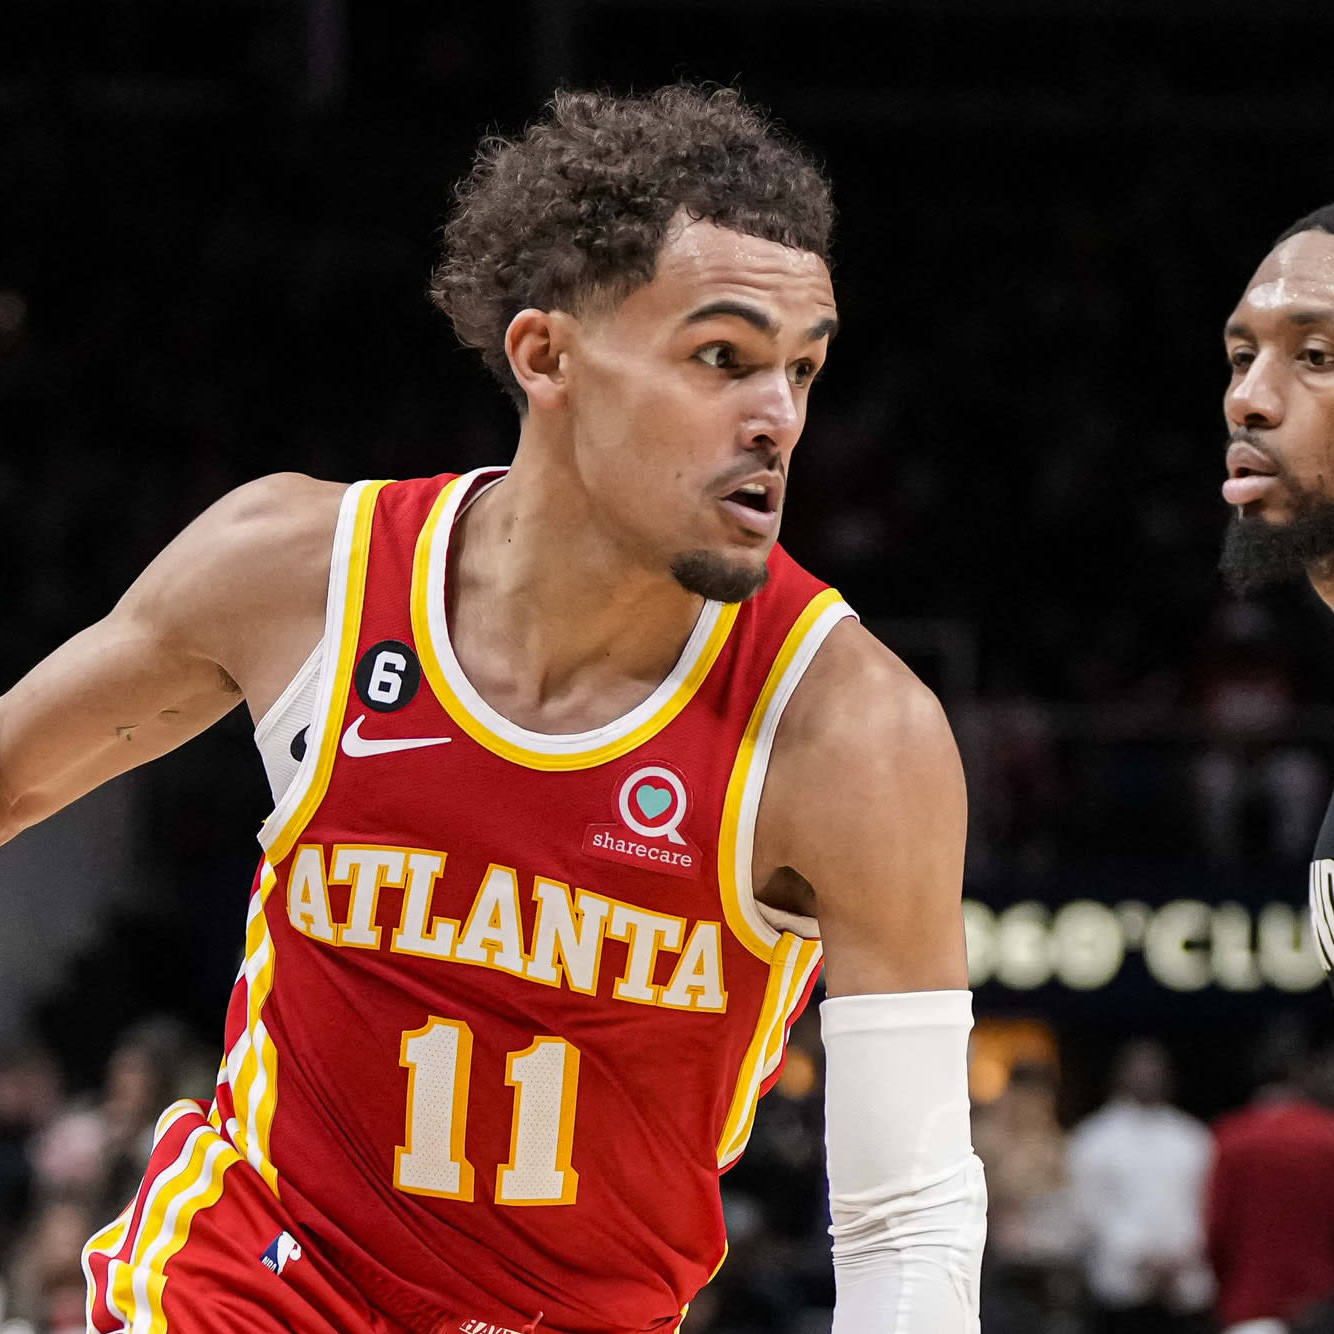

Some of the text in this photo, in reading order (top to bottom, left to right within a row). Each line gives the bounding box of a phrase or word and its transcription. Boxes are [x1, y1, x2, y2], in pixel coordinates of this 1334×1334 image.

[366, 653, 406, 704] 6
[592, 831, 693, 867] sharecare
[286, 843, 728, 1014] ATLANTA
[392, 1015, 581, 1206] 11
